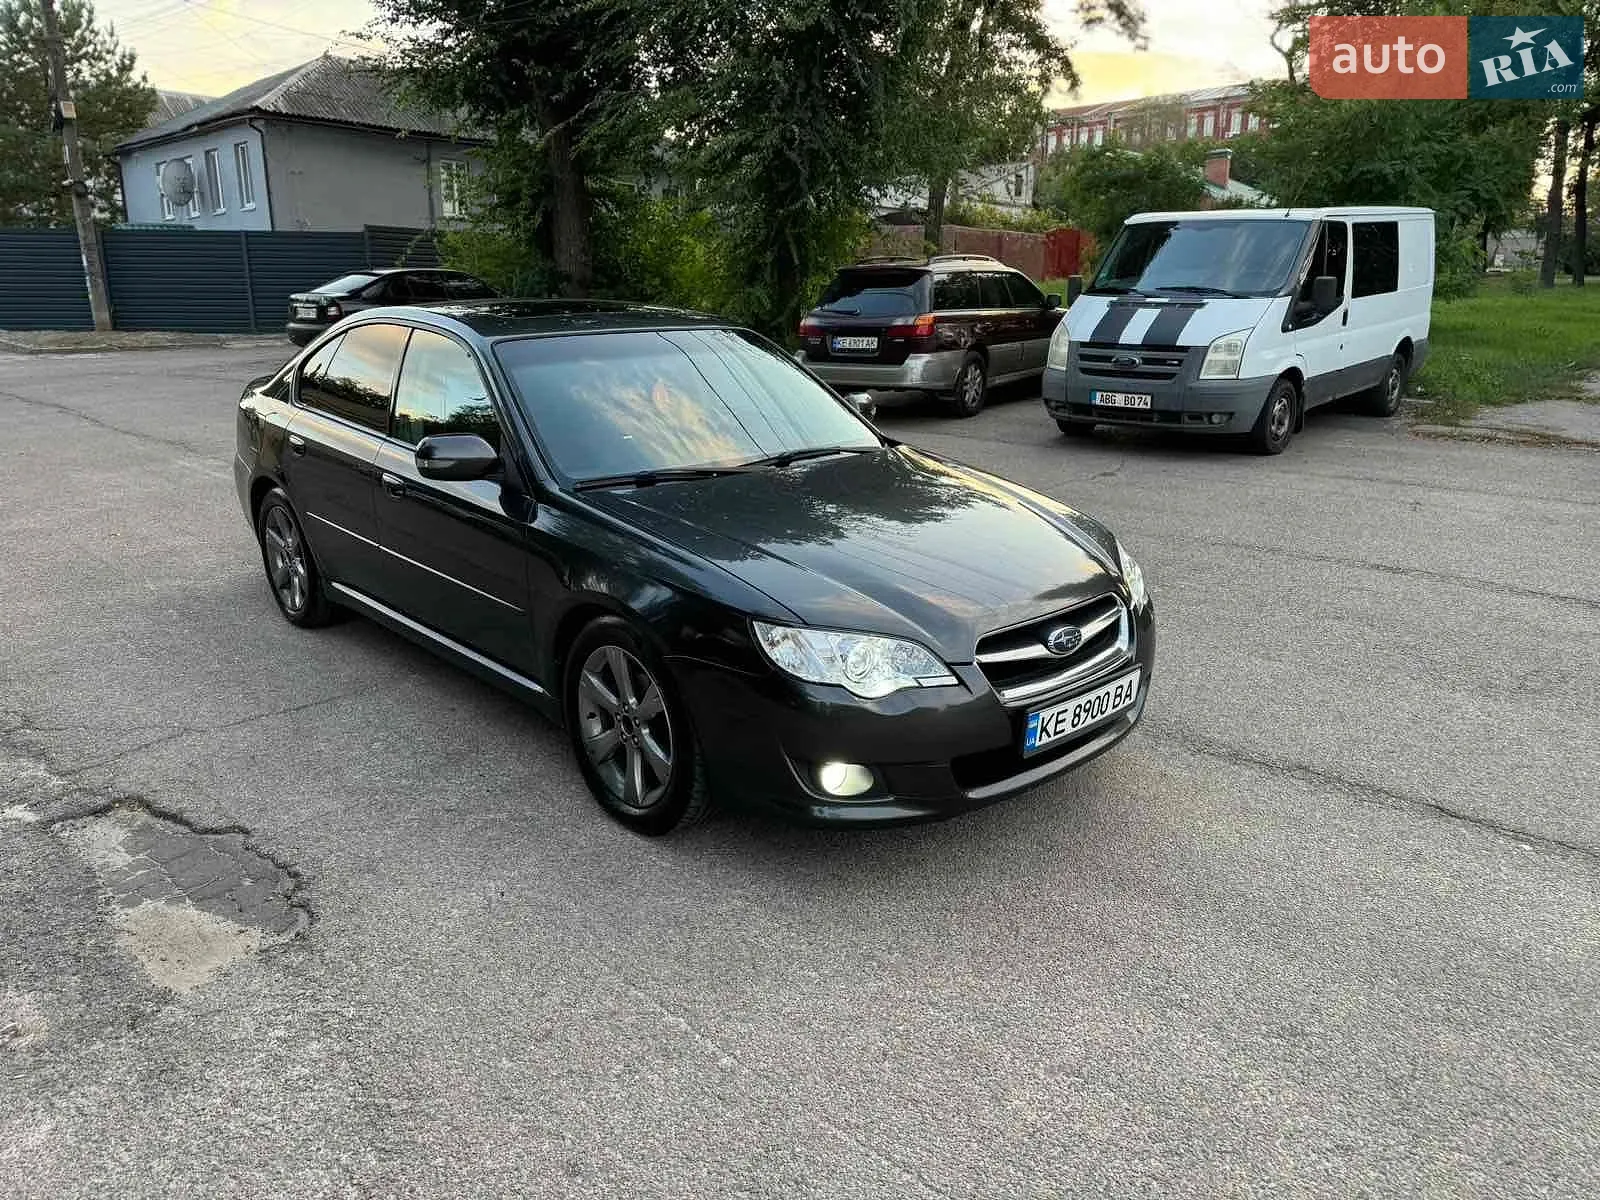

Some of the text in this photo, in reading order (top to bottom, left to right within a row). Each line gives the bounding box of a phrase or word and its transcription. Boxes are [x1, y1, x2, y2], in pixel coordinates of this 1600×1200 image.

[1100, 393, 1117, 405] ABG
[1039, 679, 1134, 742] KE 8900 BA
